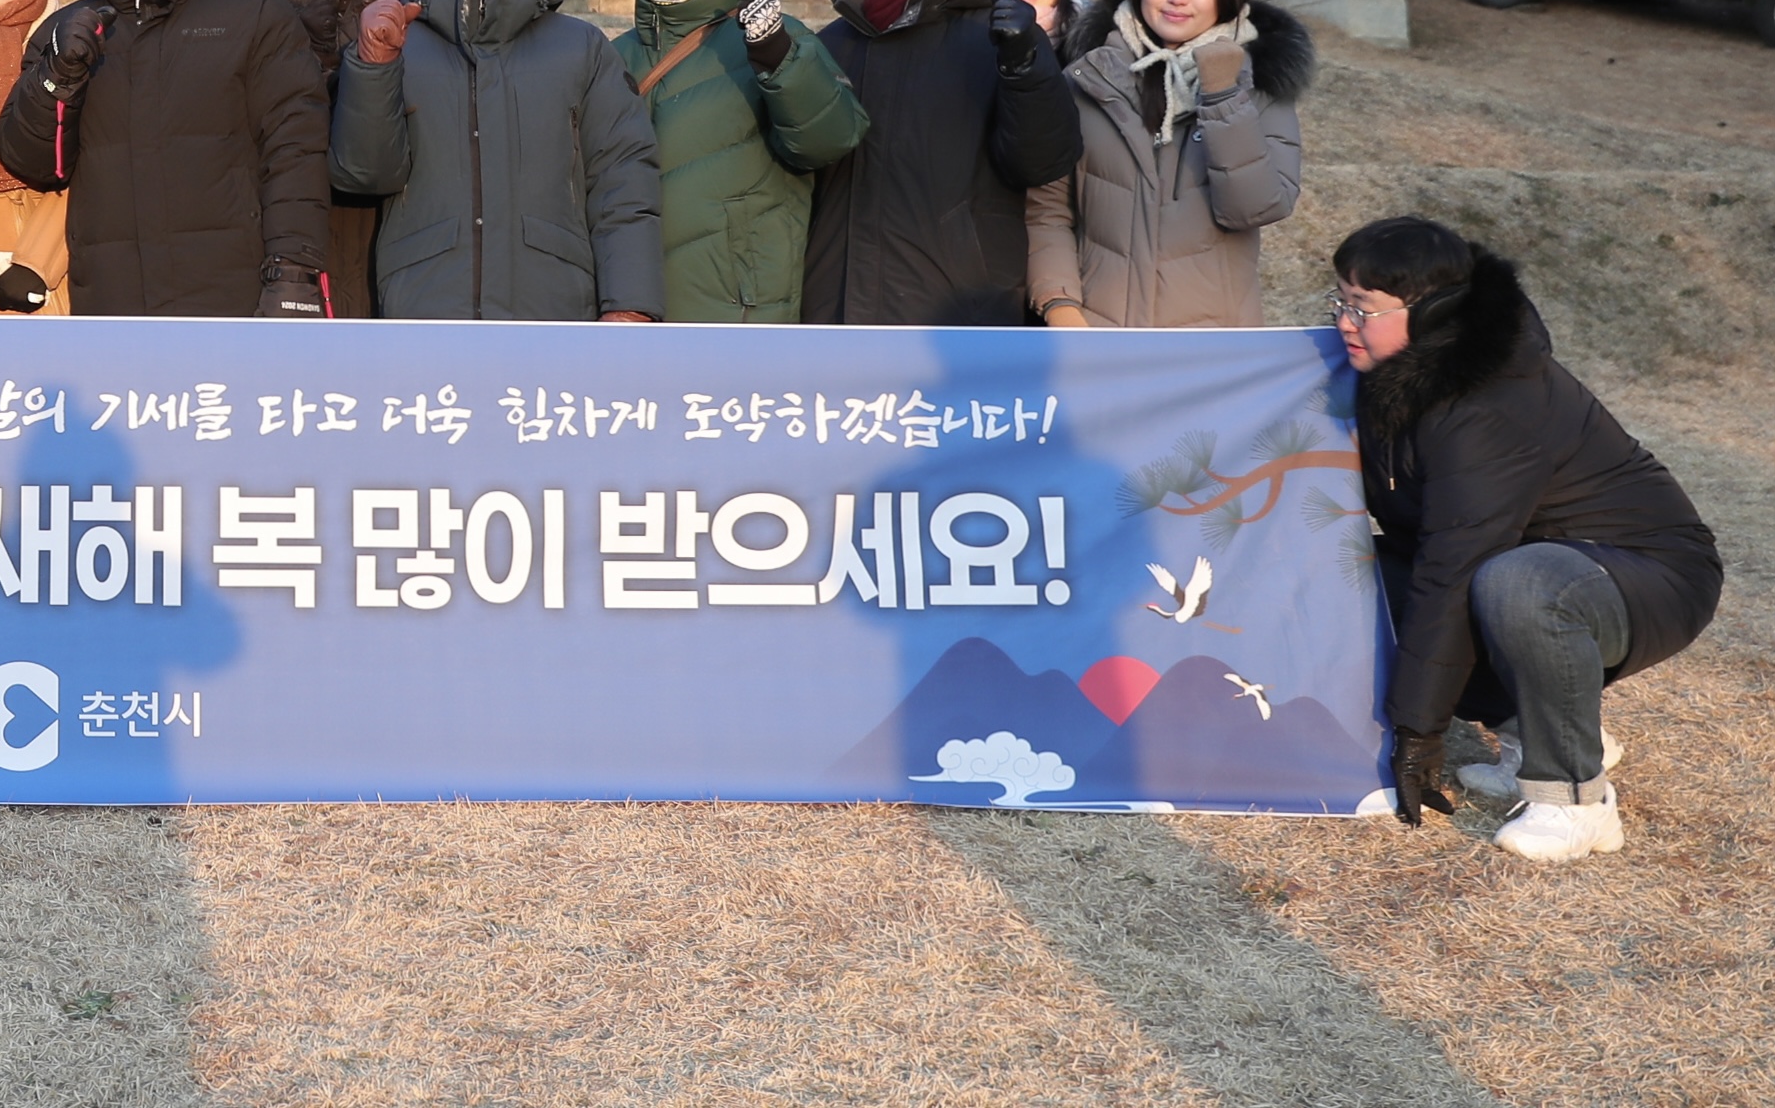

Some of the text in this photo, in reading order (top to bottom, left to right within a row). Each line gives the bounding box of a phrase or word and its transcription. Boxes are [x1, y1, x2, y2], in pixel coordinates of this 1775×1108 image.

[281, 301, 296, 310] 2024
[91, 382, 232, 441] 기세를
[257, 388, 358, 437] 타고
[382, 383, 473, 445] 더욱
[497, 386, 658, 444] 힘차게
[682, 389, 1058, 449] 도약하겠습니다!
[212, 486, 322, 608] 복
[352, 488, 565, 610] 많이
[599, 490, 1070, 611] 받으세요!
[78, 691, 201, 738] 춘천시
